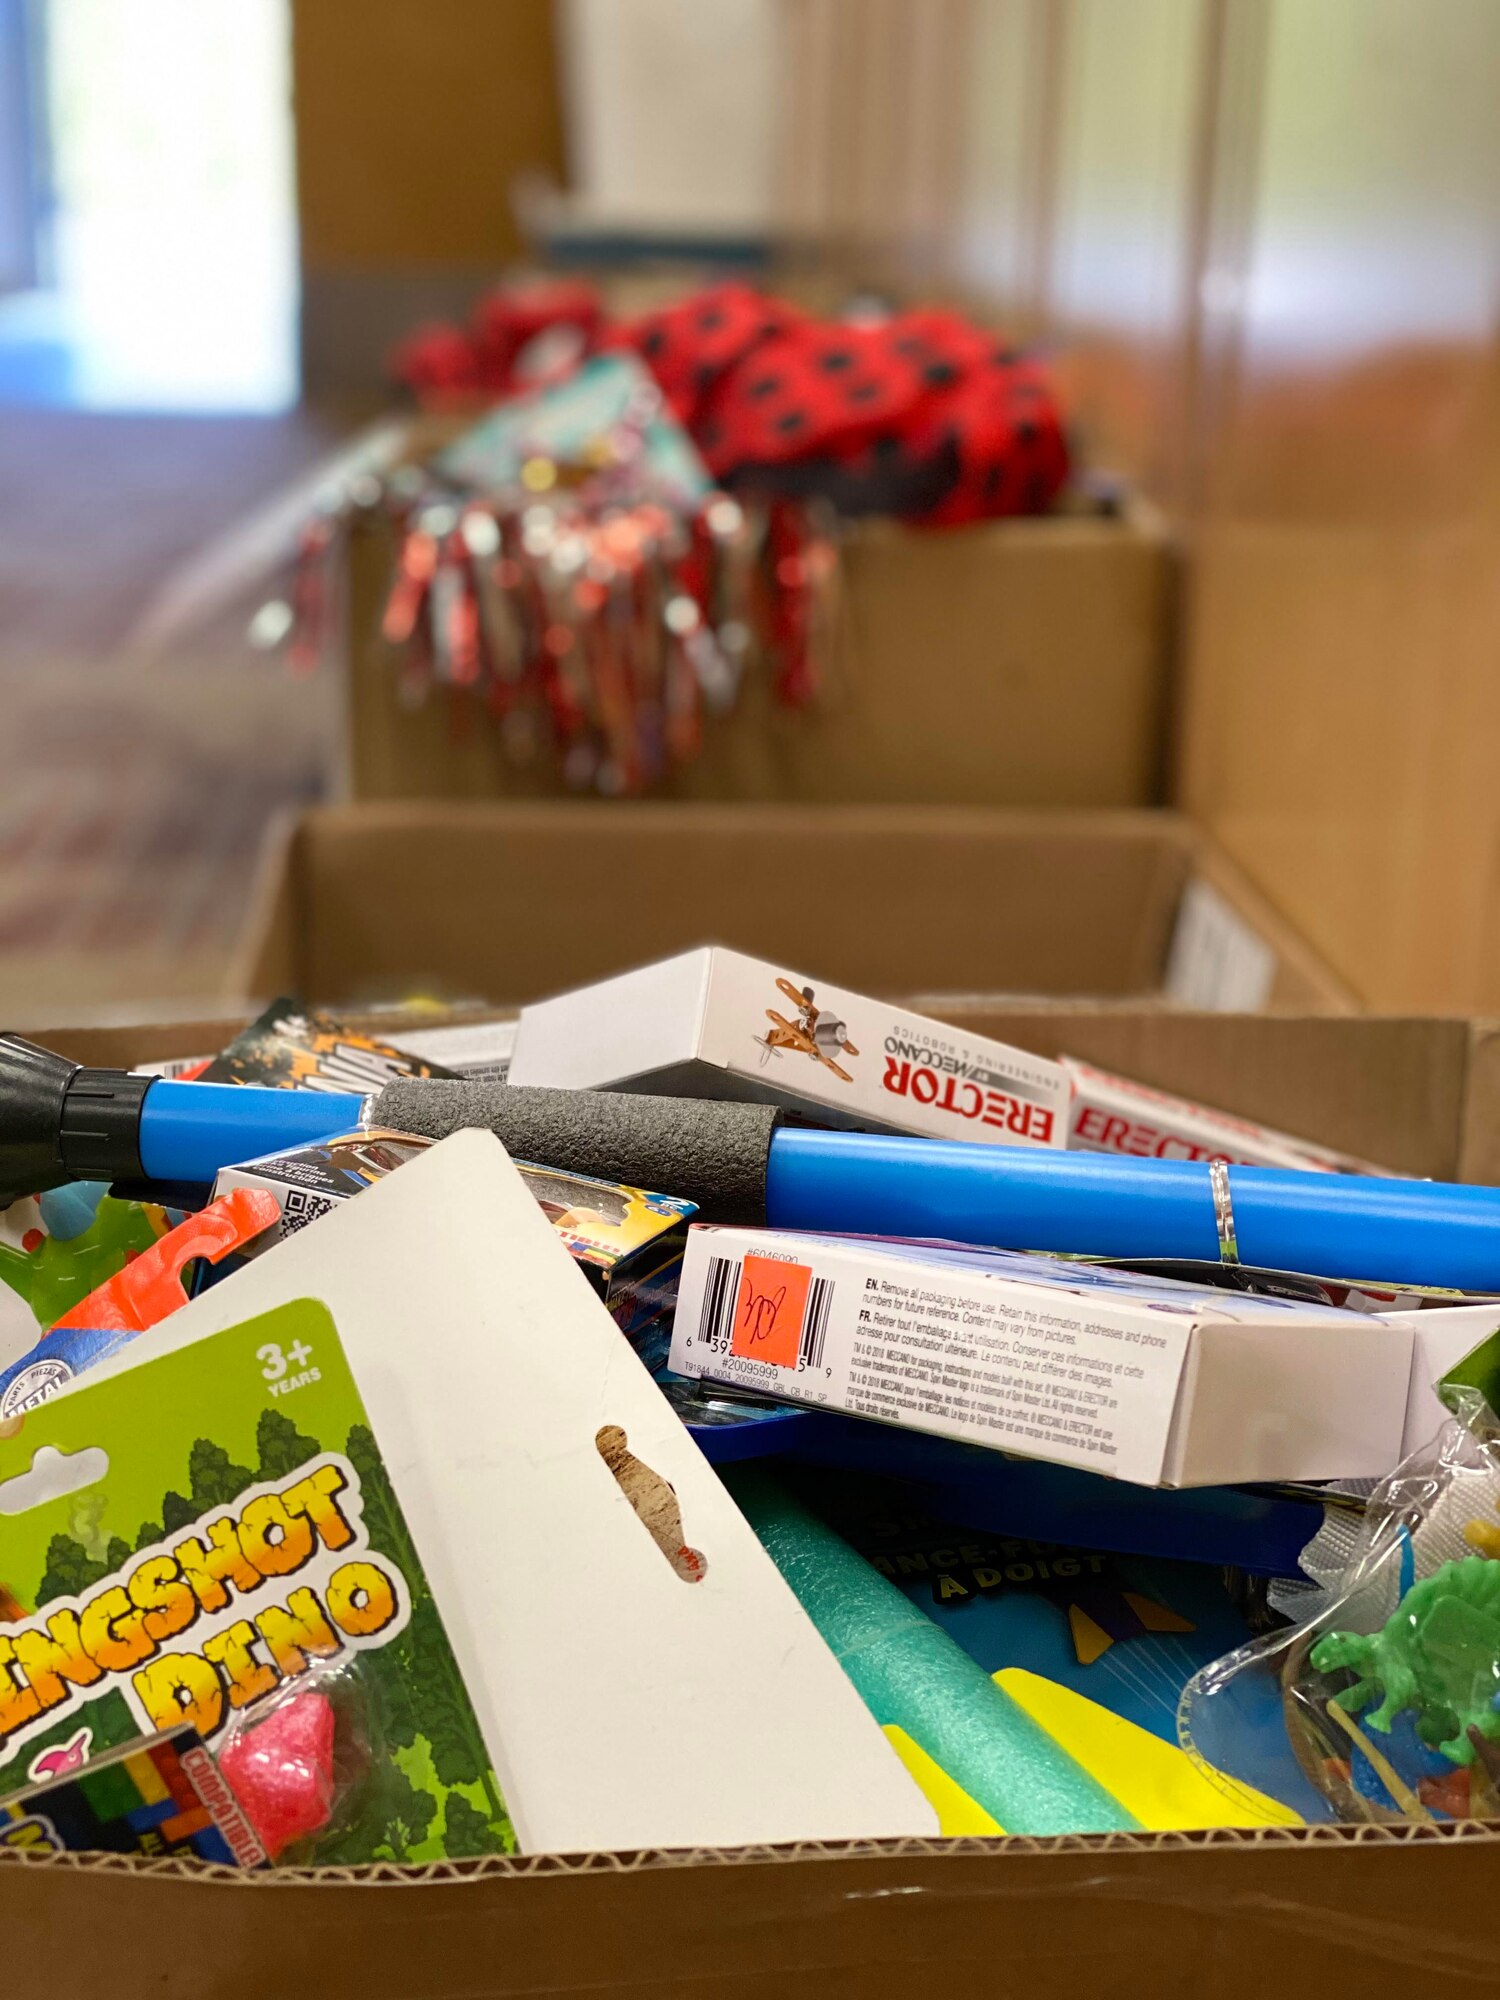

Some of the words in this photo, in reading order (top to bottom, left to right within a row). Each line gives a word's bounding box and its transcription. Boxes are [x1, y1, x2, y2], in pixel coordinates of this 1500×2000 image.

[884, 1036, 972, 1080] MECCANO
[892, 1024, 956, 1055] ROBOTICS
[976, 1055, 1060, 1091] ENGINEERING
[883, 1056, 1055, 1144] ERECTOR
[863, 1292, 892, 1308] numbers
[894, 1298, 903, 1310] for
[905, 1300, 924, 1314] future
[927, 1305, 959, 1322] reference.
[963, 1312, 991, 1329] Content
[994, 1321, 1008, 1334] may
[1010, 1324, 1024, 1337] vary
[1027, 1325, 1043, 1339] from
[1045, 1329, 1076, 1348] pictures.
[866, 1278, 879, 1292] EN.
[881, 1281, 909, 1297] Remove
[911, 1287, 920, 1300] all
[920, 1289, 956, 1309] packaging
[958, 1296, 980, 1311] before
[982, 1303, 995, 1314] use.
[1000, 1304, 1021, 1319] Retain
[1024, 1309, 1038, 1323] this
[1039, 1313, 1081, 1333] information,
[1084, 1322, 1123, 1340] addresses
[1125, 1330, 1140, 1343] and
[1141, 1333, 1167, 1351] phone
[256, 1339, 312, 1380] 3+
[685, 1335, 692, 1347] 6
[857, 1325, 883, 1340] adresse
[884, 1331, 900, 1345] pour
[902, 1334, 943, 1353] consultation
[981, 1350, 991, 1363] Le
[992, 1354, 1020, 1368] contenu
[1023, 1359, 1039, 1373] peut
[1069, 1368, 1082, 1381] des
[1085, 1372, 1112, 1390] images.
[859, 1310, 872, 1323] FR.
[874, 1313, 896, 1328] Retirer
[898, 1317, 912, 1331] tout
[913, 1321, 951, 1342] l'emballage
[975, 1334, 1010, 1352] utilisation.
[1013, 1341, 1050, 1360] Conserver
[1053, 1351, 1065, 1363] ces
[1067, 1352, 1113, 1373] informations
[1115, 1364, 1123, 1375] et
[1124, 1365, 1144, 1380] cette
[8, 1381, 25, 1406] PARTS
[31, 1368, 57, 1379] PIEZAS
[267, 1367, 321, 1398] YEARS
[721, 1357, 778, 1380] #20095999
[825, 1366, 832, 1379] 9
[971, 1554, 1107, 1590] DOIGT
[0, 1464, 357, 1749] INGSHOT
[132, 1561, 400, 1742] DINO
